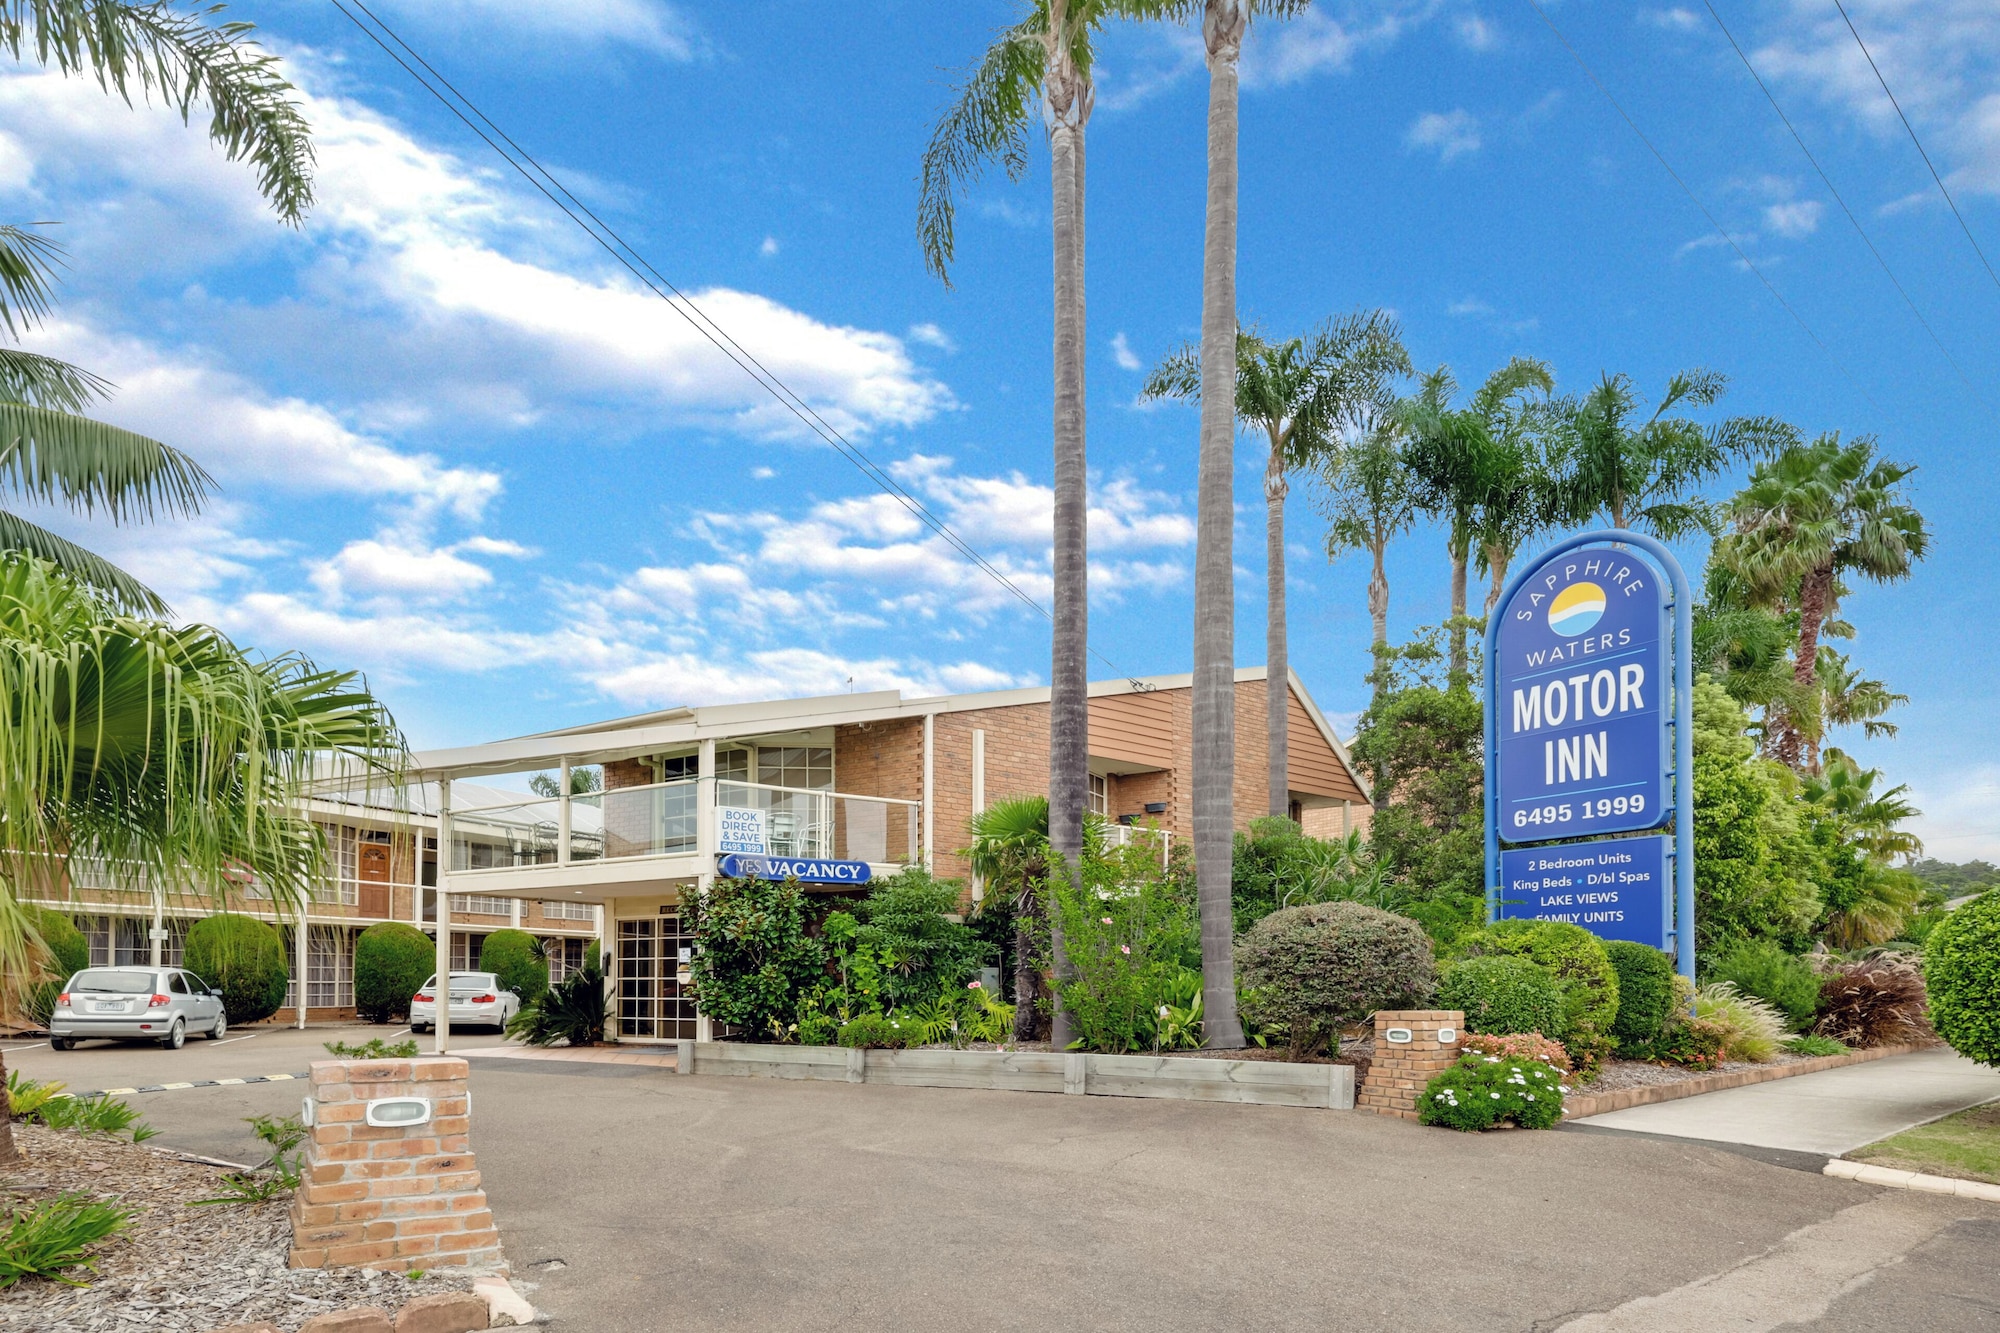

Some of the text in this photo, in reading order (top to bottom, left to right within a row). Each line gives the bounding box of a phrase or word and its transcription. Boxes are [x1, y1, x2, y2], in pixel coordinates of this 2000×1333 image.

[1517, 560, 1643, 622] SAPPHIRE
[1526, 628, 1631, 667] WATERS
[1513, 663, 1645, 733] MOTOR
[1545, 731, 1608, 785] INN
[726, 810, 757, 822] BOOK
[1514, 795, 1645, 827] 6495 1999
[722, 820, 761, 832] DIRECT
[723, 831, 760, 842] & SAVE
[722, 843, 762, 853] 6495 1999
[735, 858, 861, 879] YES VACANCY
[1528, 853, 1632, 871] 2 Bedroom Units
[1513, 871, 1650, 892] King Beds D/bl Spas
[1541, 891, 1619, 907] LAKE VIEWS
[1584, 910, 1624, 923] UNITS
